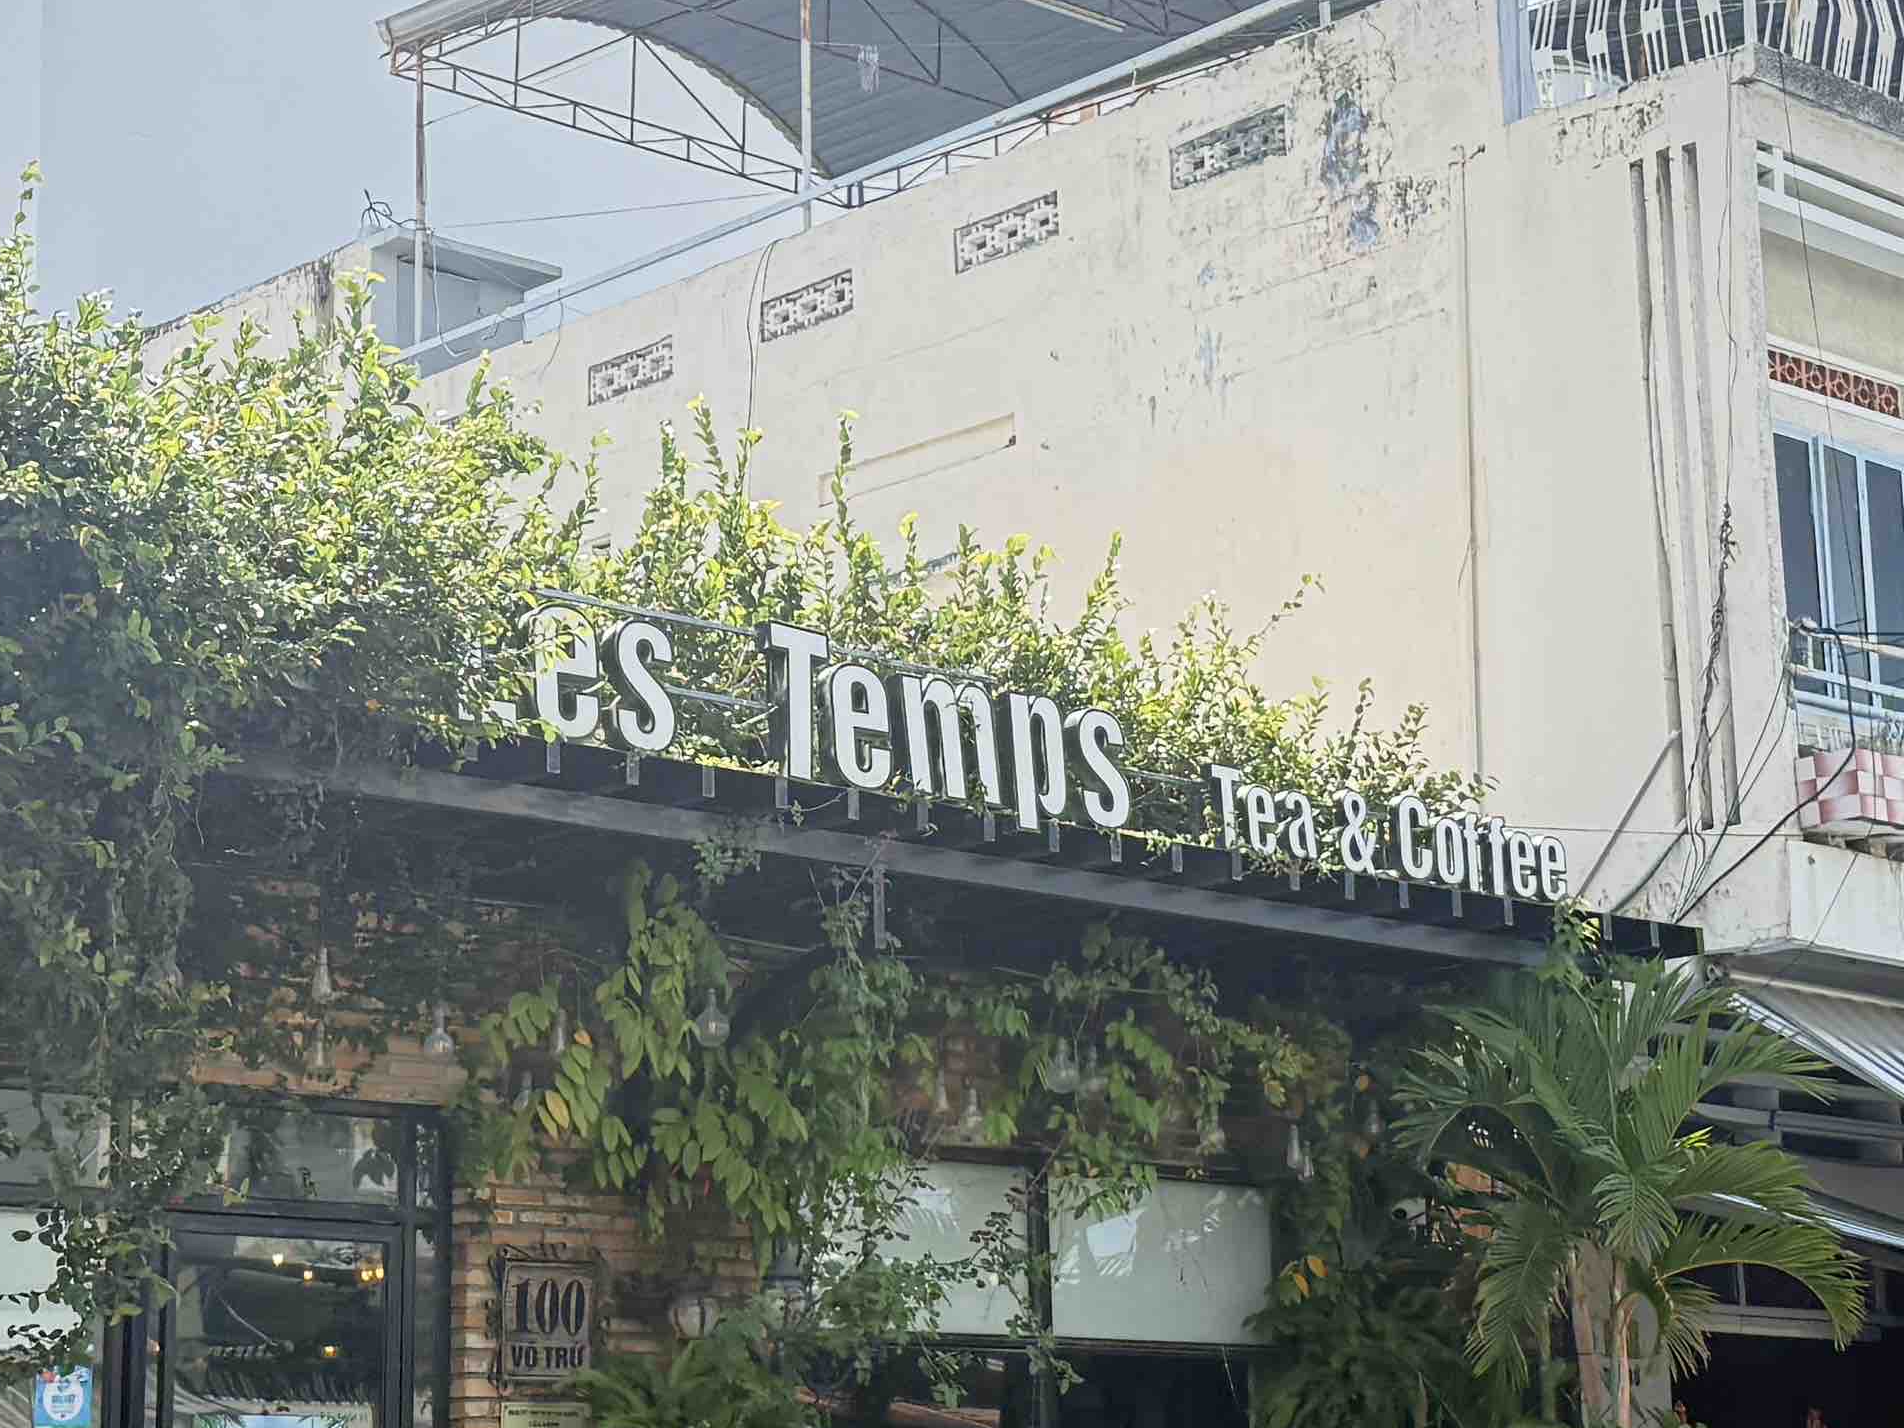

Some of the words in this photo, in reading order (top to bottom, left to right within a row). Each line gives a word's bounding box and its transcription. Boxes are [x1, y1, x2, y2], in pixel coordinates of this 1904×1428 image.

[458, 604, 675, 752] es
[762, 619, 1131, 830] Temps
[1210, 763, 1318, 860] Tea
[1339, 789, 1377, 875] &
[1394, 794, 1568, 902] Coffee
[511, 1277, 586, 1337] 100
